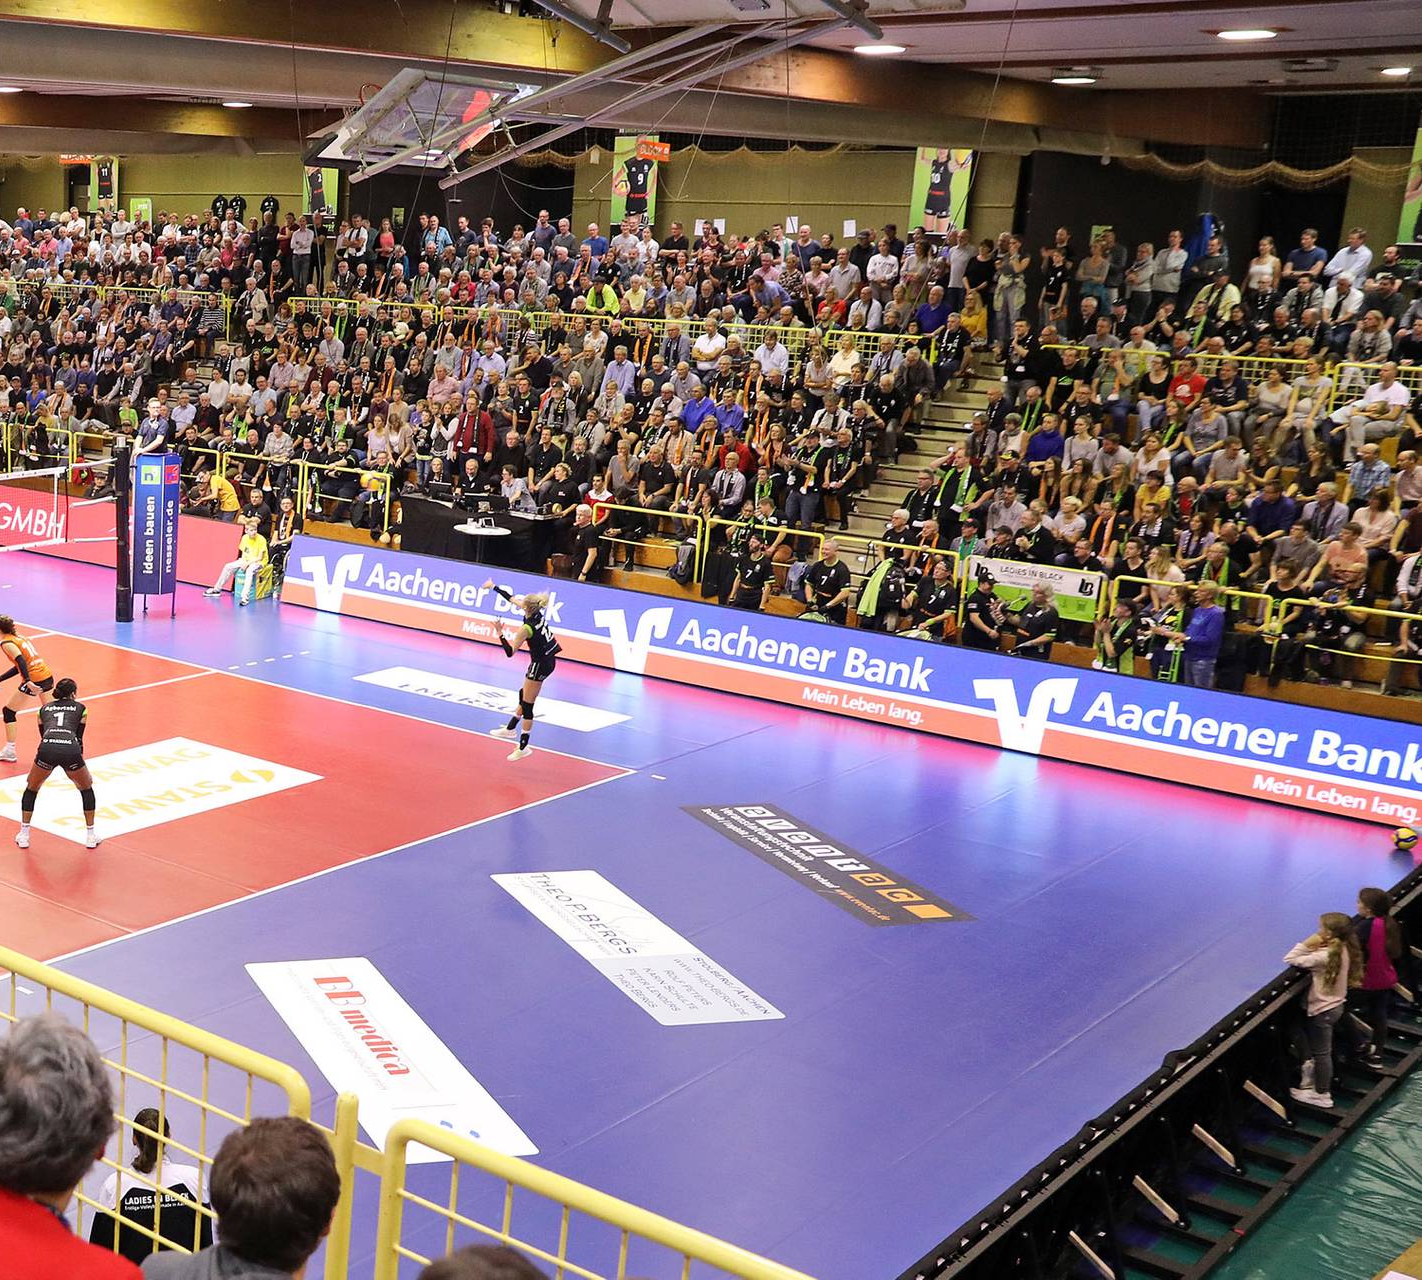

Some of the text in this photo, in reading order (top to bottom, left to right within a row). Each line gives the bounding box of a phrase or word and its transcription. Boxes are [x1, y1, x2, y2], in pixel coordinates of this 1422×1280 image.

[638, 173, 644, 185] 9
[931, 173, 941, 183] 10
[142, 496, 156, 574] ideen bauen
[165, 500, 174, 573] nesseler.de
[365, 560, 564, 624] Aachener Bak
[746, 570, 753, 579] 7
[821, 576, 828, 585] 7
[1000, 565, 1028, 576] LADIES
[1028, 570, 1038, 578] IN
[1039, 571, 1065, 581] BLACK
[929, 594, 936, 604] 7
[462, 620, 491, 637] Mein
[676, 618, 934, 692] Aachener Bank
[53, 711, 65, 727] 1
[802, 687, 924, 724] Mein Leben lang.
[1082, 691, 1422, 785] Aachener Bank
[45, 746, 211, 792] SAWAG
[1252, 774, 1421, 825] Mein Leben lang.
[735, 806, 924, 902] eventac
[527, 873, 643, 954] THEO P. BERGS
[339, 1009, 410, 1076] medica
[124, 1195, 153, 1205] LADIES
